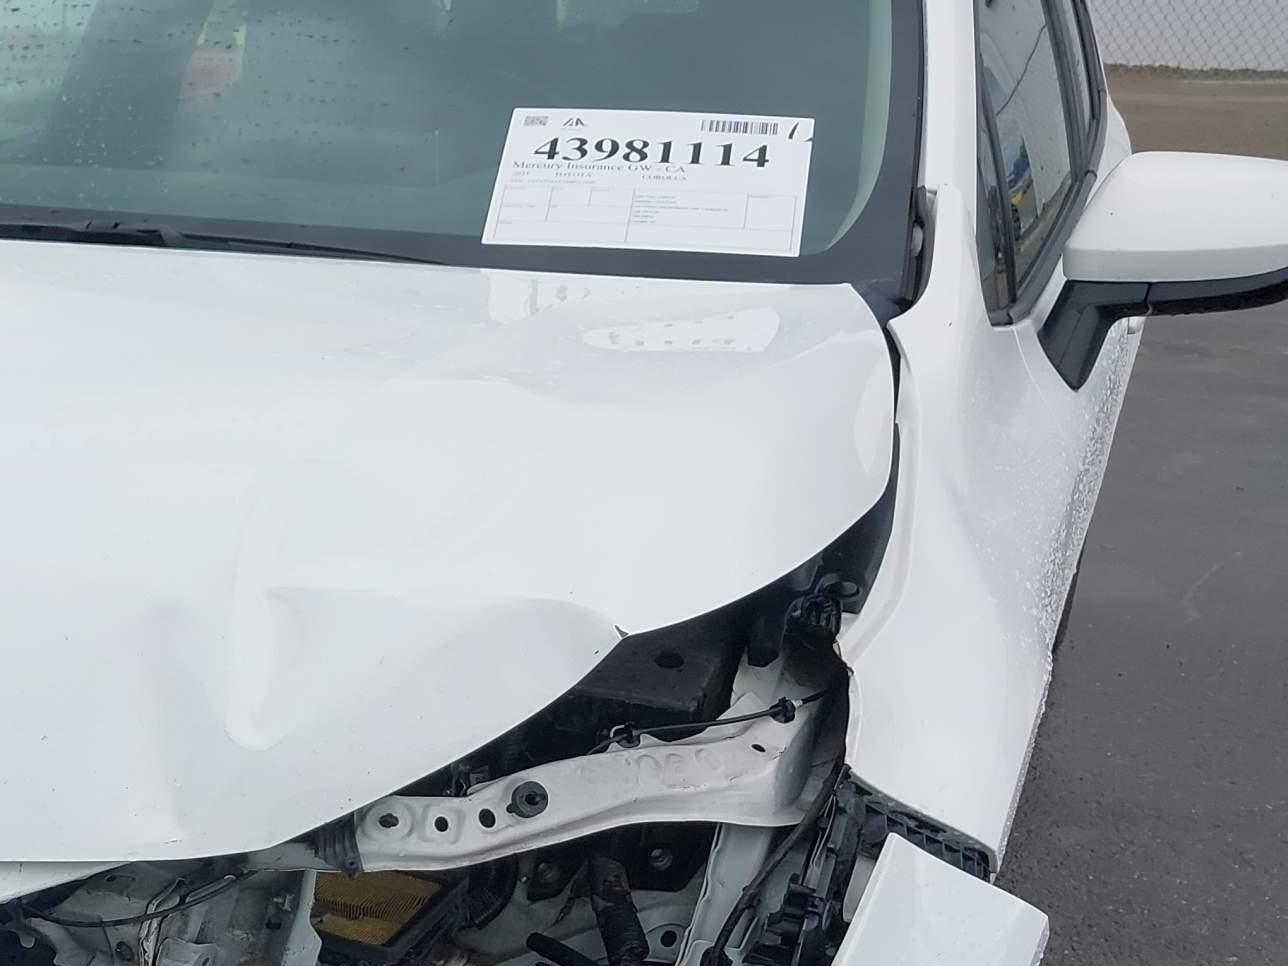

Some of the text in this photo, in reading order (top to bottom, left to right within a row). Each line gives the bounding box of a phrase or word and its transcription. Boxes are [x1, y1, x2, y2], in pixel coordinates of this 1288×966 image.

[533, 136, 770, 168] 43981114
[512, 161, 562, 171] Mercury
[566, 162, 625, 171] Insurance
[627, 163, 652, 172] GW
[665, 165, 686, 174] CA
